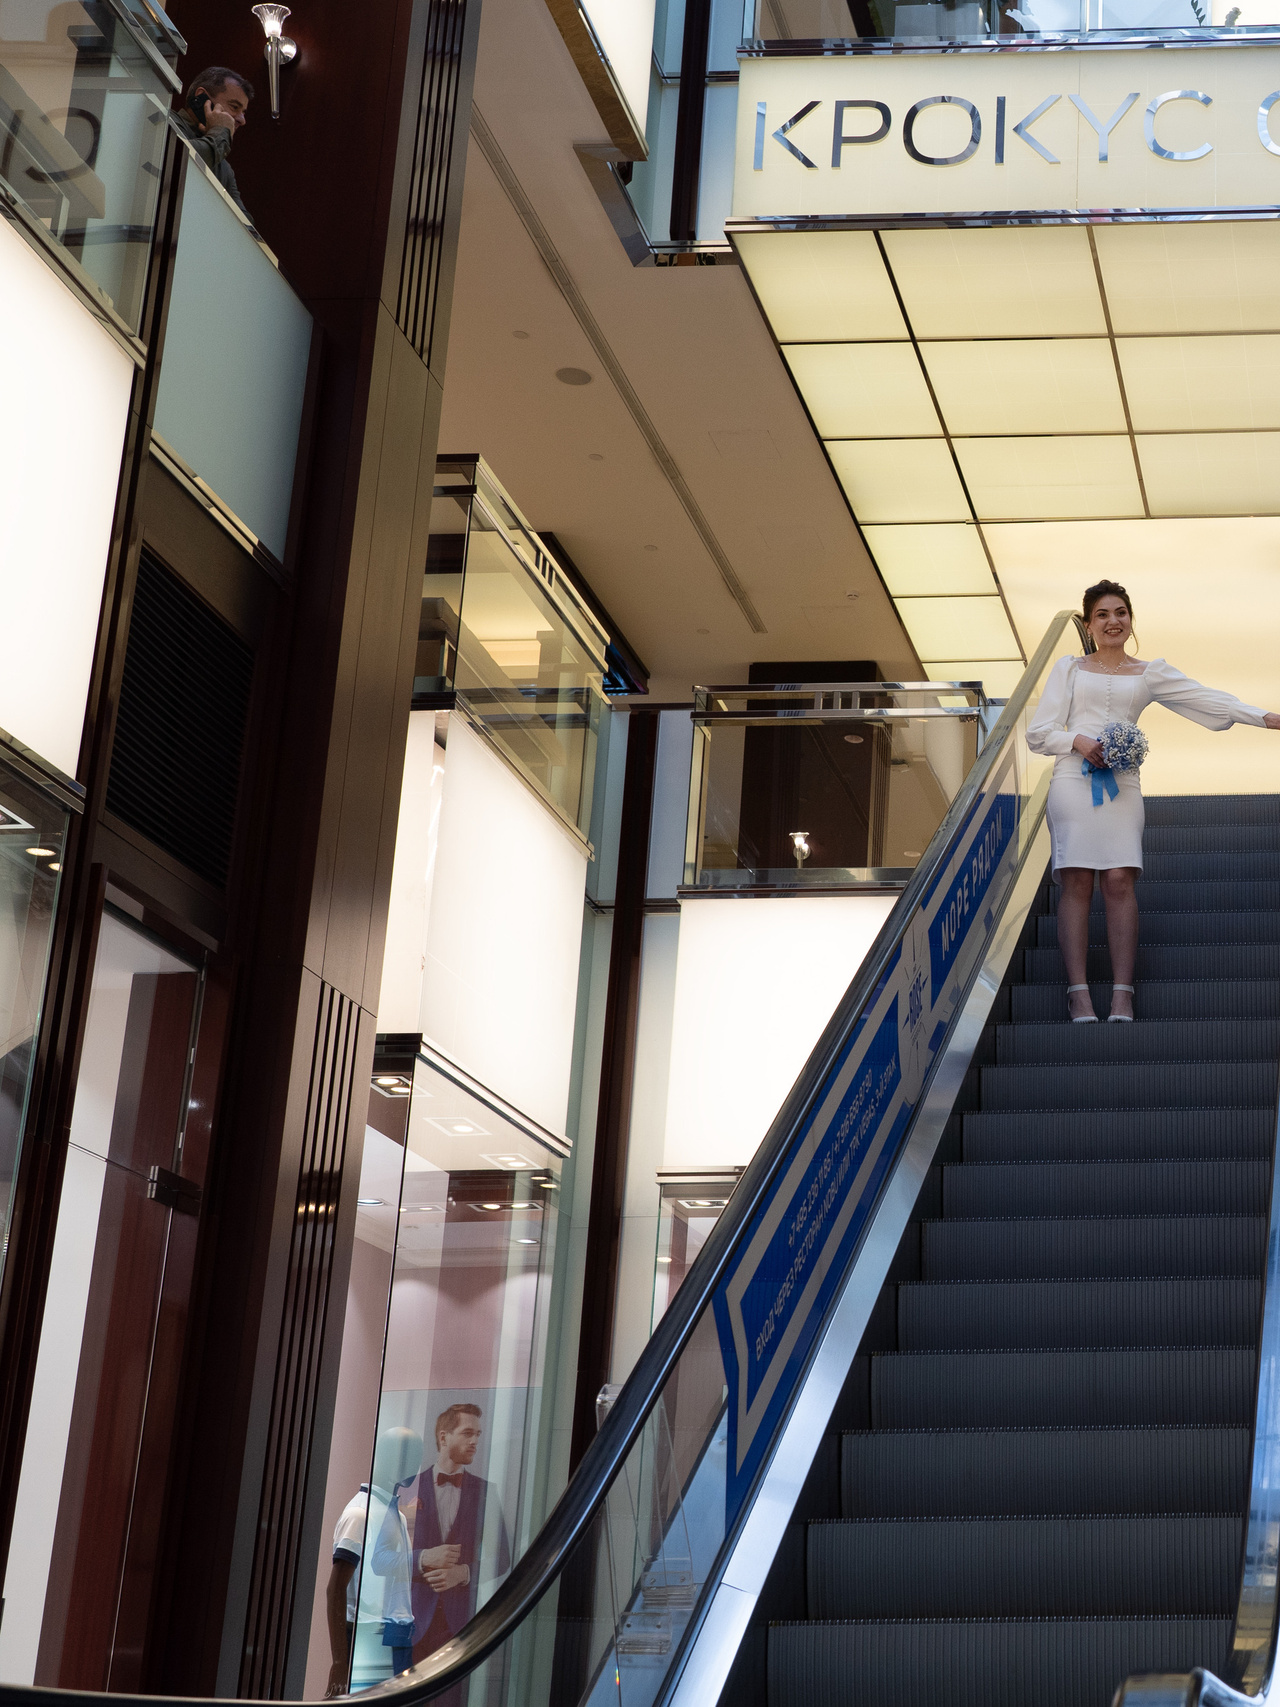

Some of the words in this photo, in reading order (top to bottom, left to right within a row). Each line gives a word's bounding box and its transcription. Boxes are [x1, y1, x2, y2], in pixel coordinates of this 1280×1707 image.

[753, 89, 1215, 171] КРОКУС
[941, 872, 970, 961] МОРЕ
[972, 806, 1003, 898] РЯДОМ
[796, 1198, 808, 1233] 495
[755, 1307, 775, 1362] ВХОД
[774, 1266, 795, 1318] ЧЕРЕЗ
[793, 1203, 824, 1281] РЕСТОРАН
